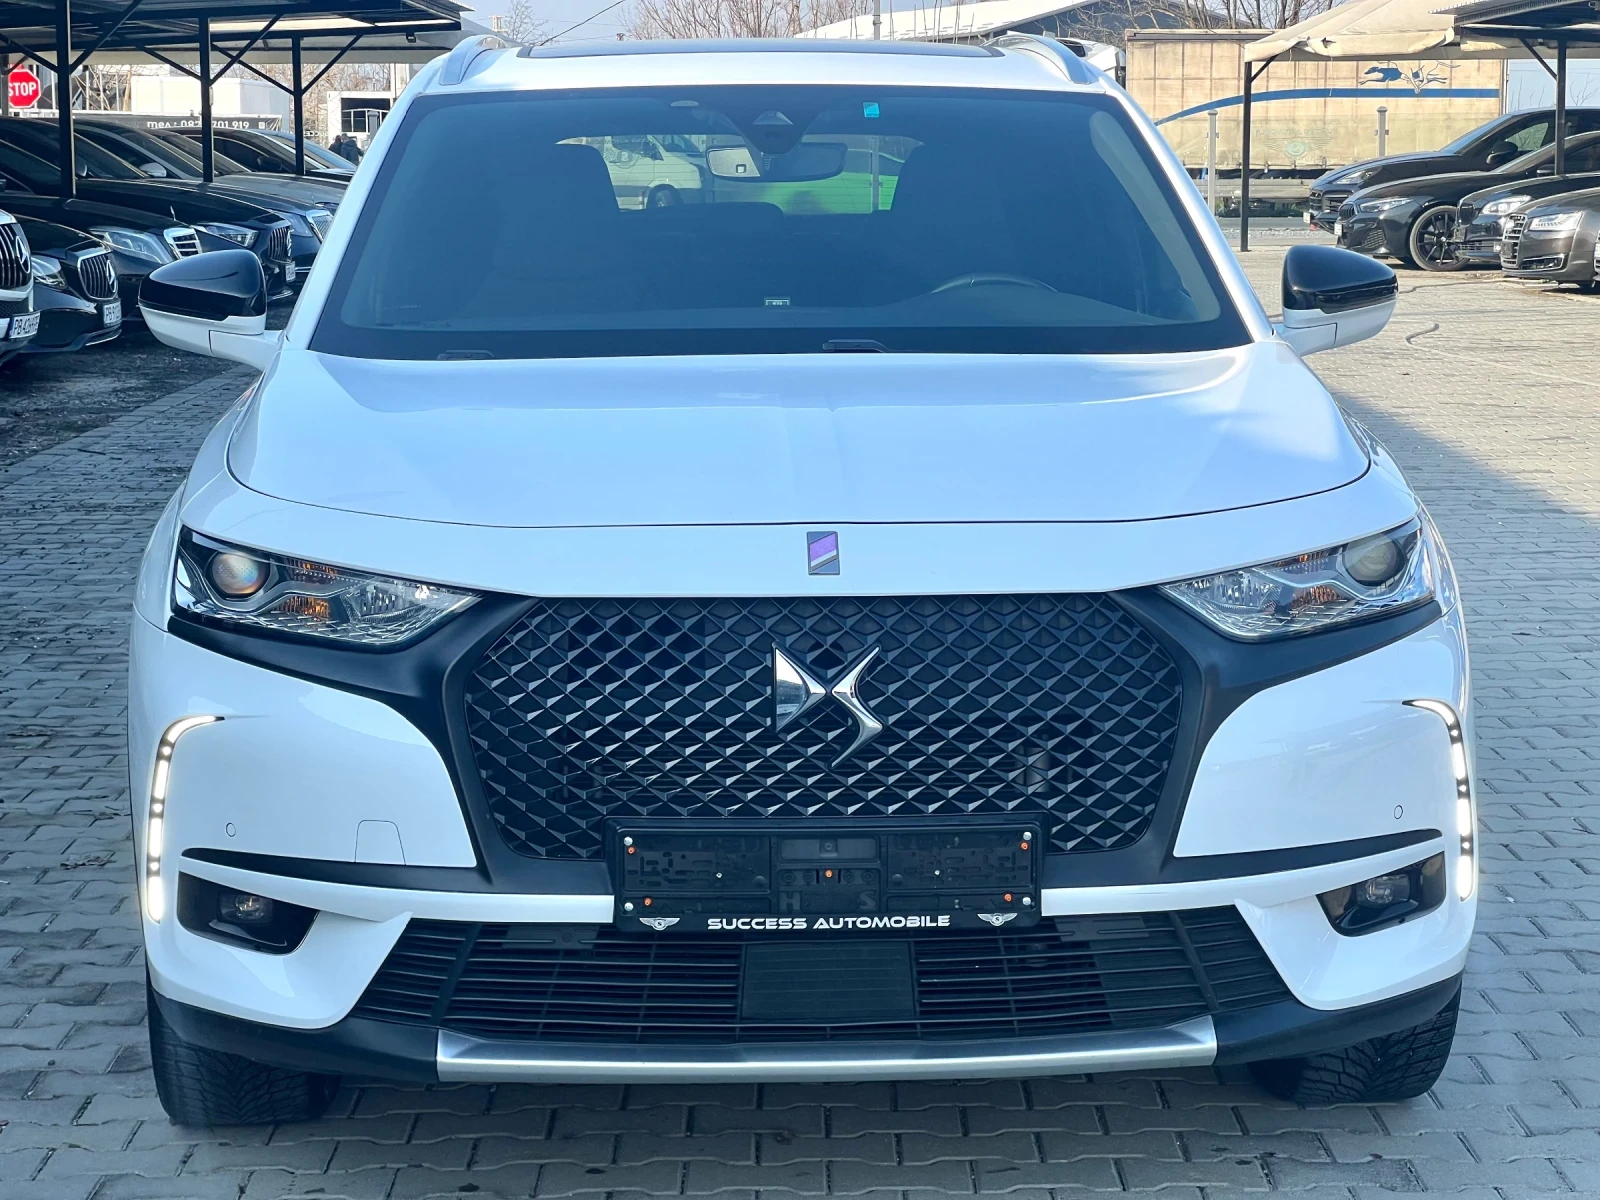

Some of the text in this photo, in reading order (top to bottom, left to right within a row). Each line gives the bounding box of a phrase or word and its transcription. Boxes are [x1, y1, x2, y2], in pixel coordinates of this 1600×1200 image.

[8, 81, 37, 97] STOP
[707, 914, 951, 930] SUCCESS AUTOMOBILE
